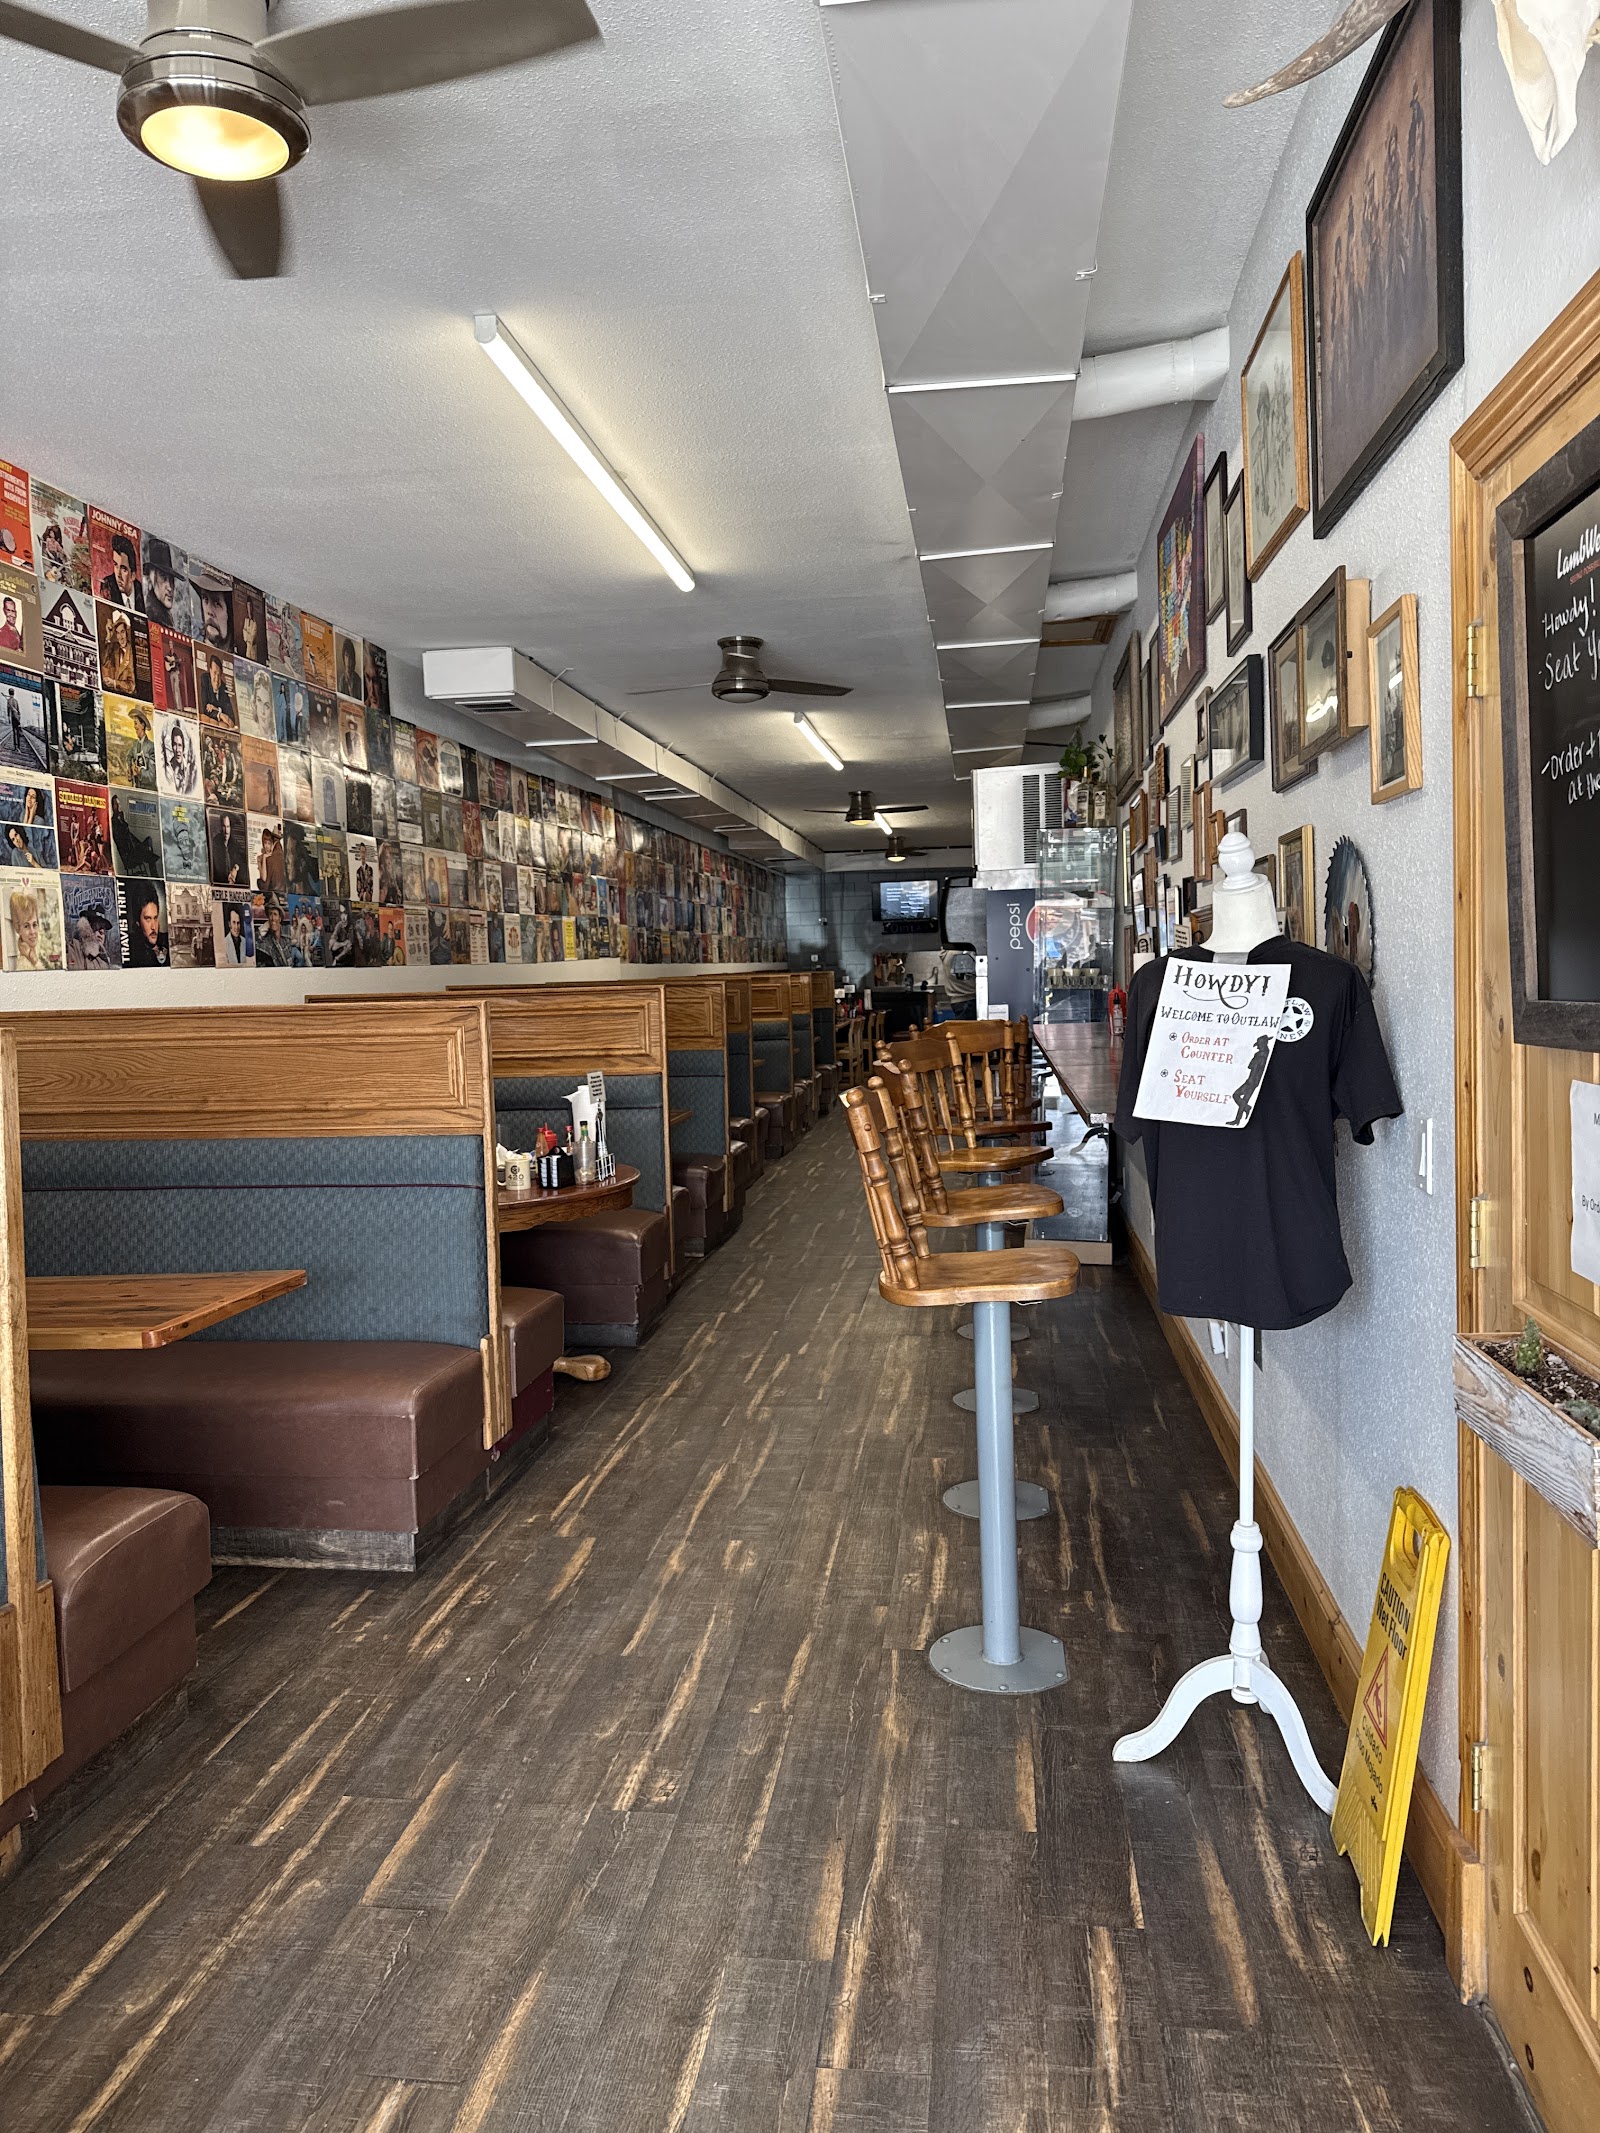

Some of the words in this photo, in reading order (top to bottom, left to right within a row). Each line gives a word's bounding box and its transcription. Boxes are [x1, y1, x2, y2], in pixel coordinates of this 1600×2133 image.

[91, 509, 122, 531] JOHNNY
[123, 524, 138, 540] SEA
[1541, 577, 1597, 638] Howdy!
[58, 791, 84, 806] SQUARE
[117, 881, 127, 918] TRITT
[211, 890, 229, 902] MERLE
[229, 891, 252, 903] HAGGARD
[119, 920, 131, 964] TRAVIS
[1006, 903, 1024, 950] pepsi
[1231, 1012, 1281, 1028] OUTLAW
[1180, 1045, 1234, 1065] COUNTER
[1380, 1571, 1411, 1635] CAUTION
[1376, 1593, 1390, 1634] Wet
[1388, 1616, 1408, 1661] Floor
[1364, 1750, 1384, 1795] Mojado
